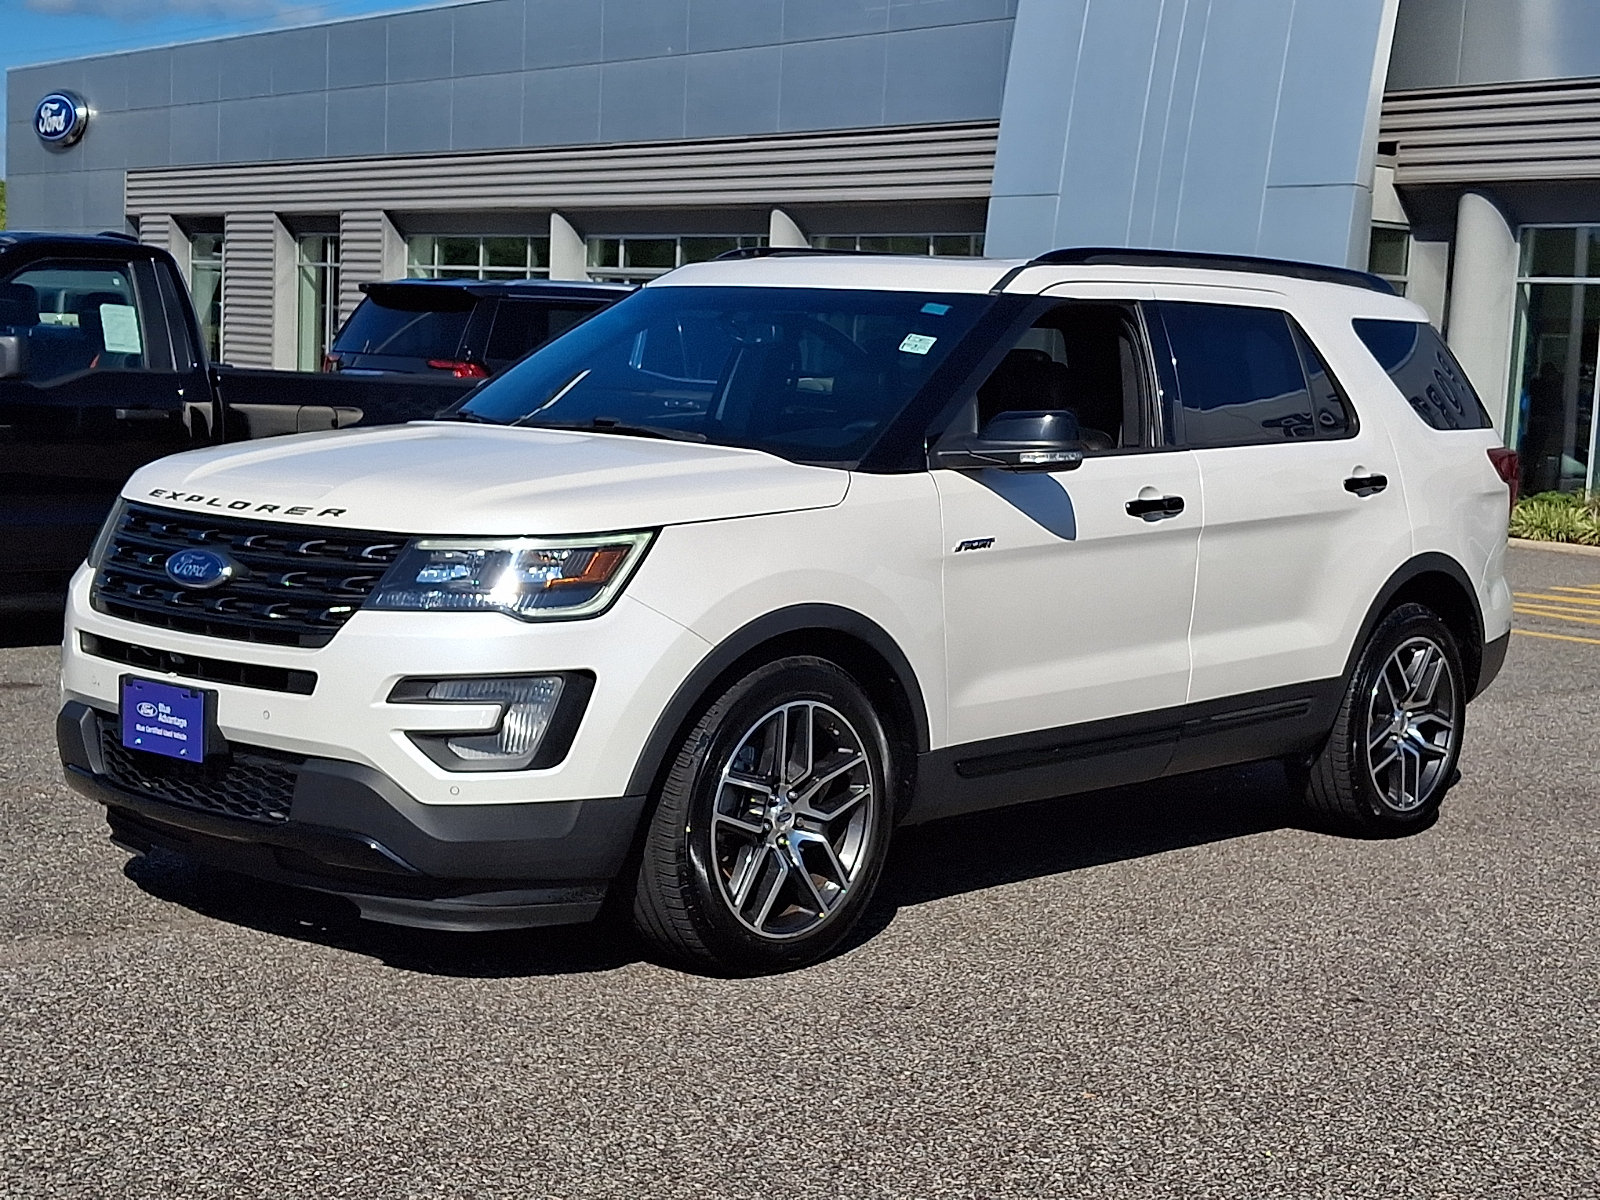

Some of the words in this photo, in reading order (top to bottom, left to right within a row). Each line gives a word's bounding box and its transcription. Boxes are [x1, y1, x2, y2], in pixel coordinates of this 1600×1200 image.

[39, 103, 66, 133] Ford
[149, 488, 347, 517] EXPLORER
[173, 554, 211, 577] Ford
